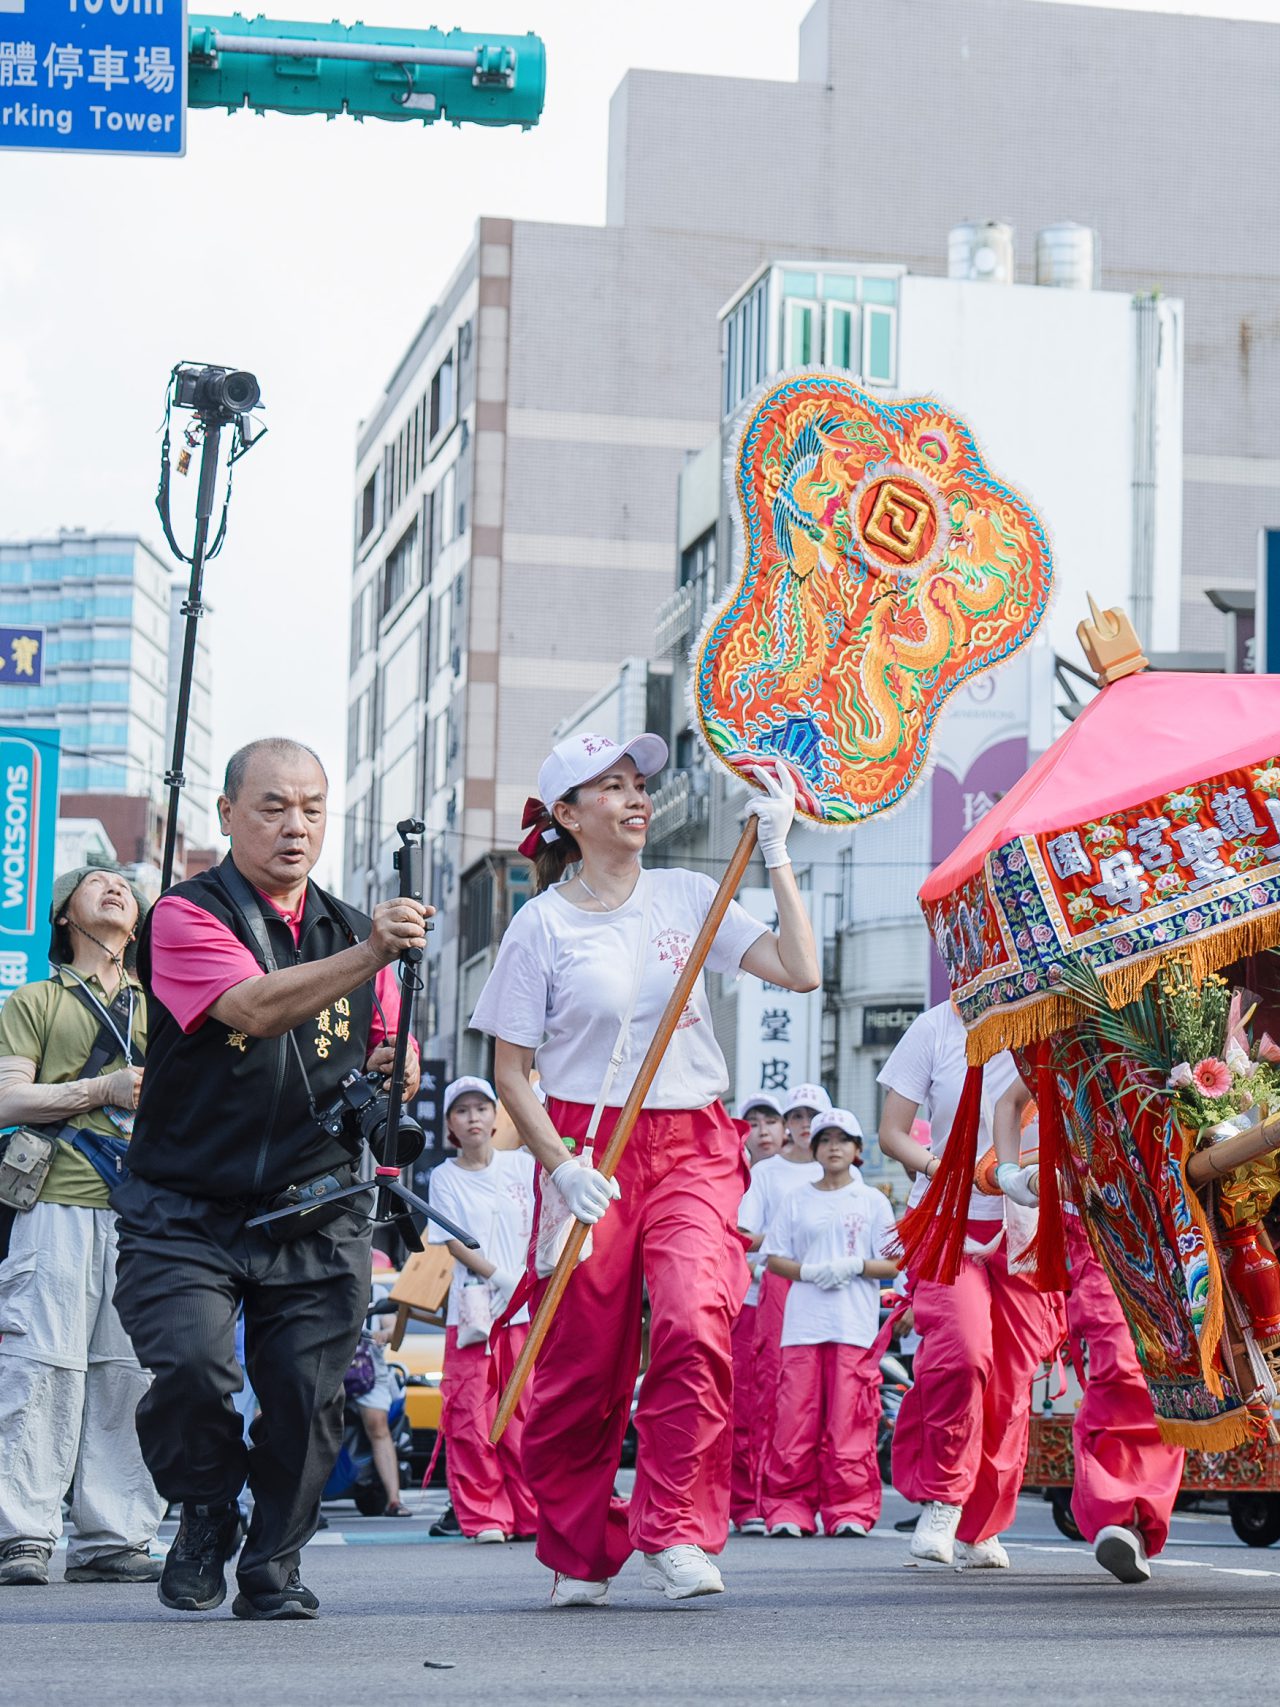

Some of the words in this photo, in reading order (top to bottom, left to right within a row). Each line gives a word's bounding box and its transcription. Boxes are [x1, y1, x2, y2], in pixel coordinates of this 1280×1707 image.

[0, 102, 73, 135] rking
[89, 105, 175, 133] Tower
[2, 764, 29, 909] watsons
